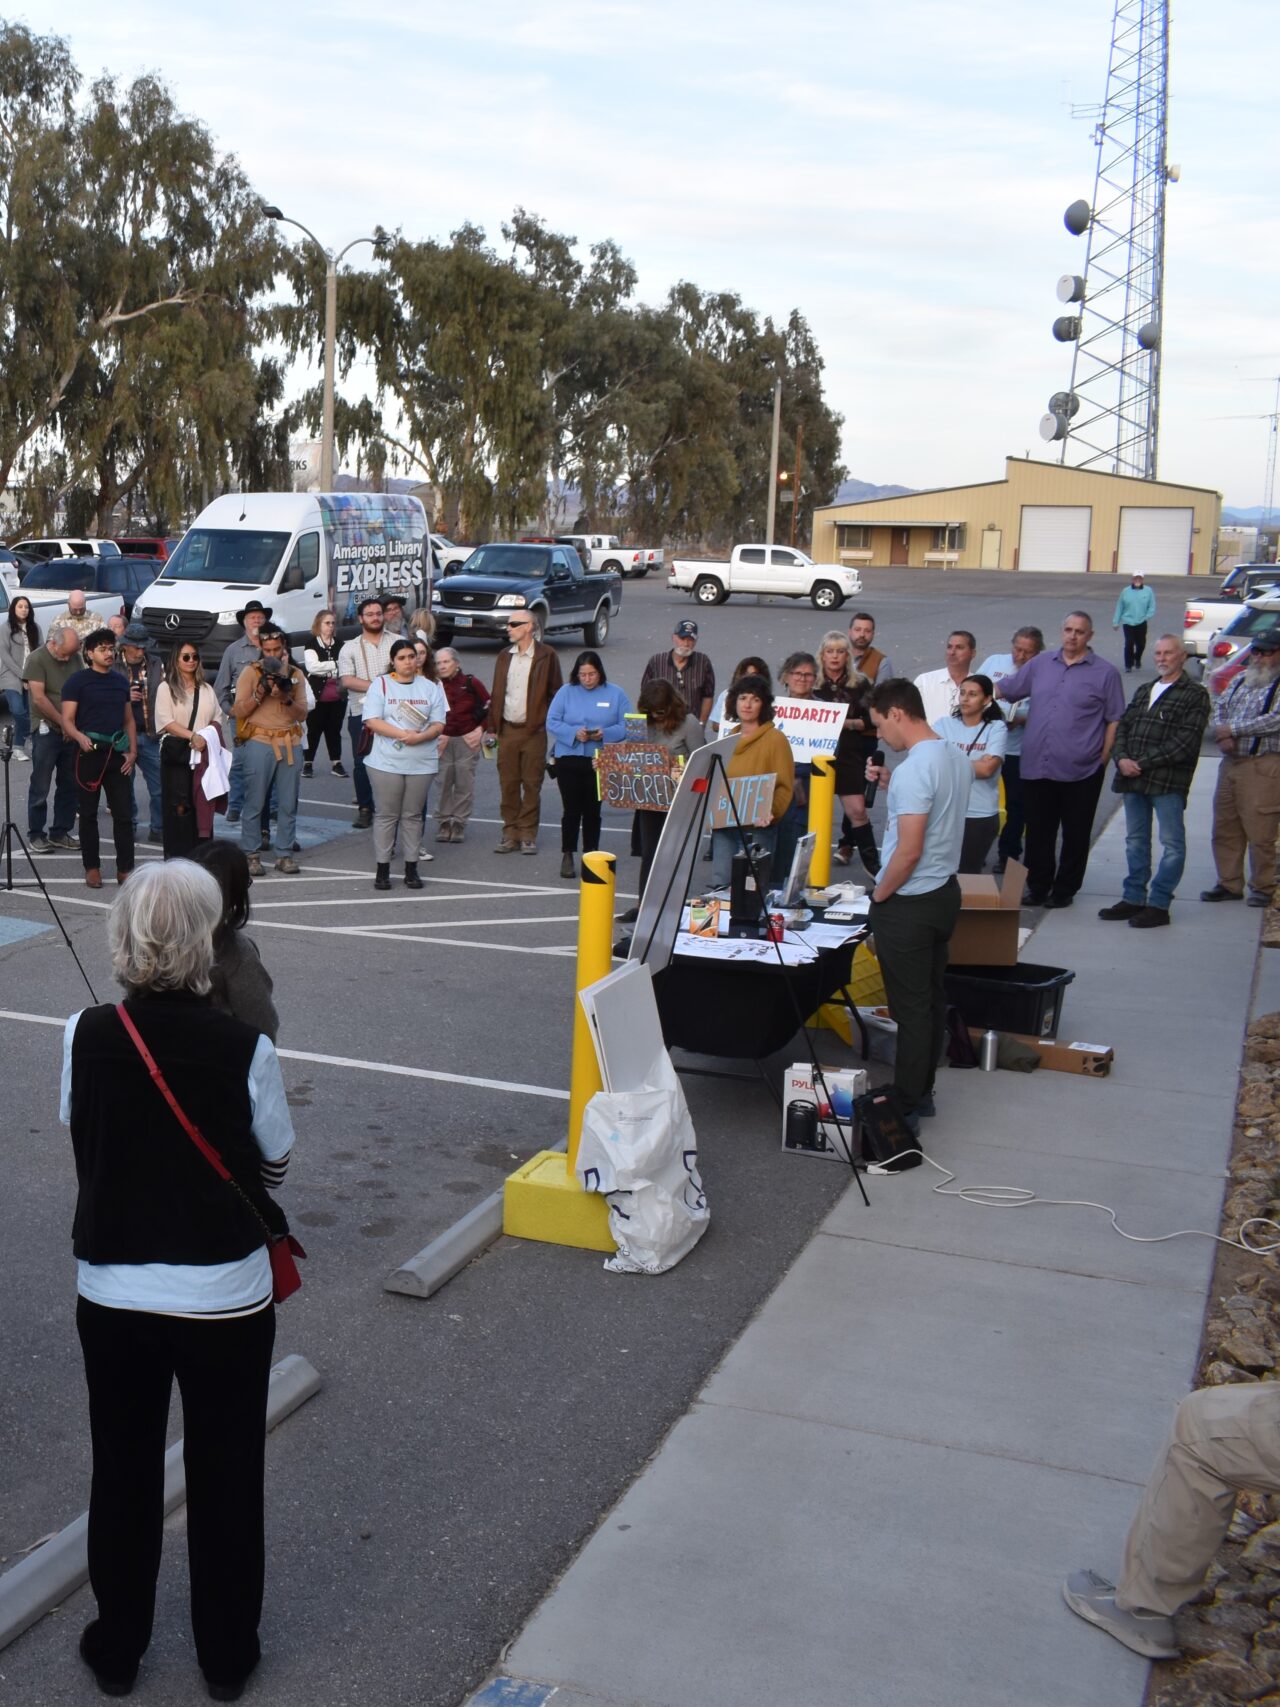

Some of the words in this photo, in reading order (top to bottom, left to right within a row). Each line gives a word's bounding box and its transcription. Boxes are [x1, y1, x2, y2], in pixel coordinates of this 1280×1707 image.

[333, 544, 386, 561] Amargosa
[389, 540, 422, 557] Library
[336, 559, 423, 592] EXPRESS
[773, 706, 841, 723] SOLIDARITY
[808, 738, 838, 750] WATER
[617, 752, 663, 765] WATER
[608, 773, 677, 806] SACRED
